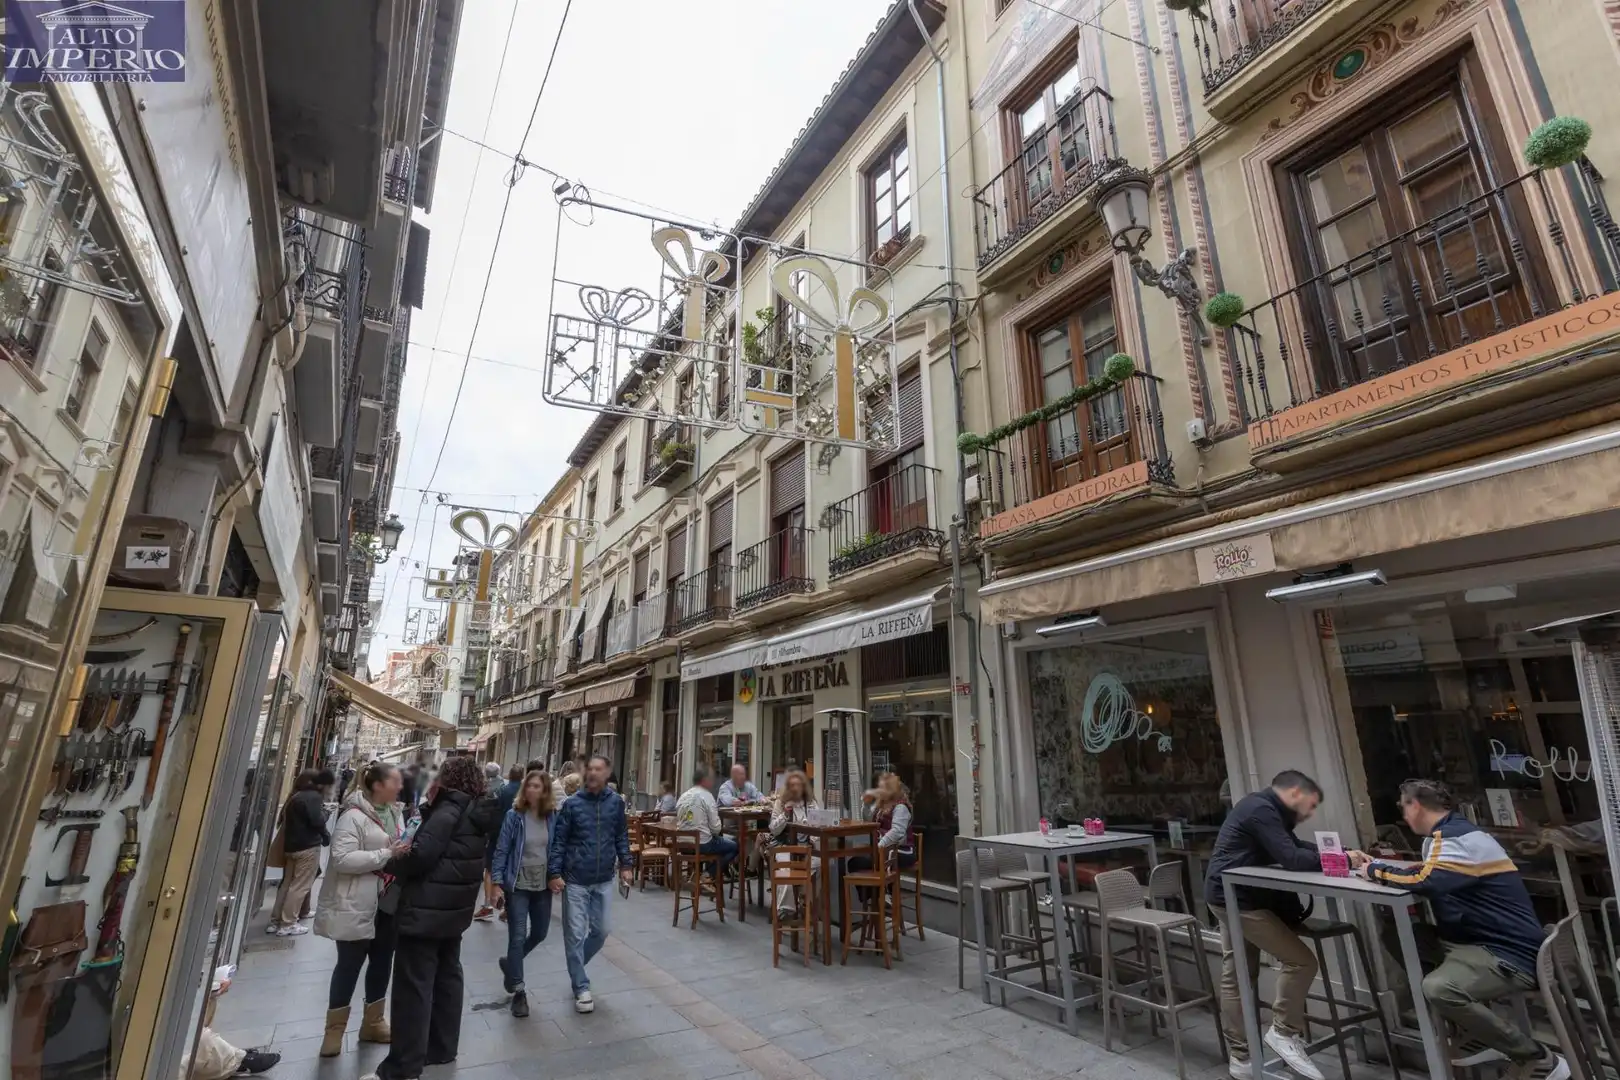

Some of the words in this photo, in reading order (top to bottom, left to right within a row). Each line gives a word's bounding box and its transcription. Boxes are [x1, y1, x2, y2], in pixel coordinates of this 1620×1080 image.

[205, 0, 232, 129] Distribuidor
[1282, 363, 1451, 433] APARTAMENTOS
[998, 508, 1037, 530] CASA
[1053, 467, 1142, 510] CATEDRAL
[1215, 549, 1249, 569] ROLLO
[861, 627, 875, 639] LA
[878, 612, 923, 635] RIFFEÑA
[758, 675, 777, 698] LA
[782, 658, 849, 695] RIFFEÑA
[1490, 739, 1593, 782] Roll
